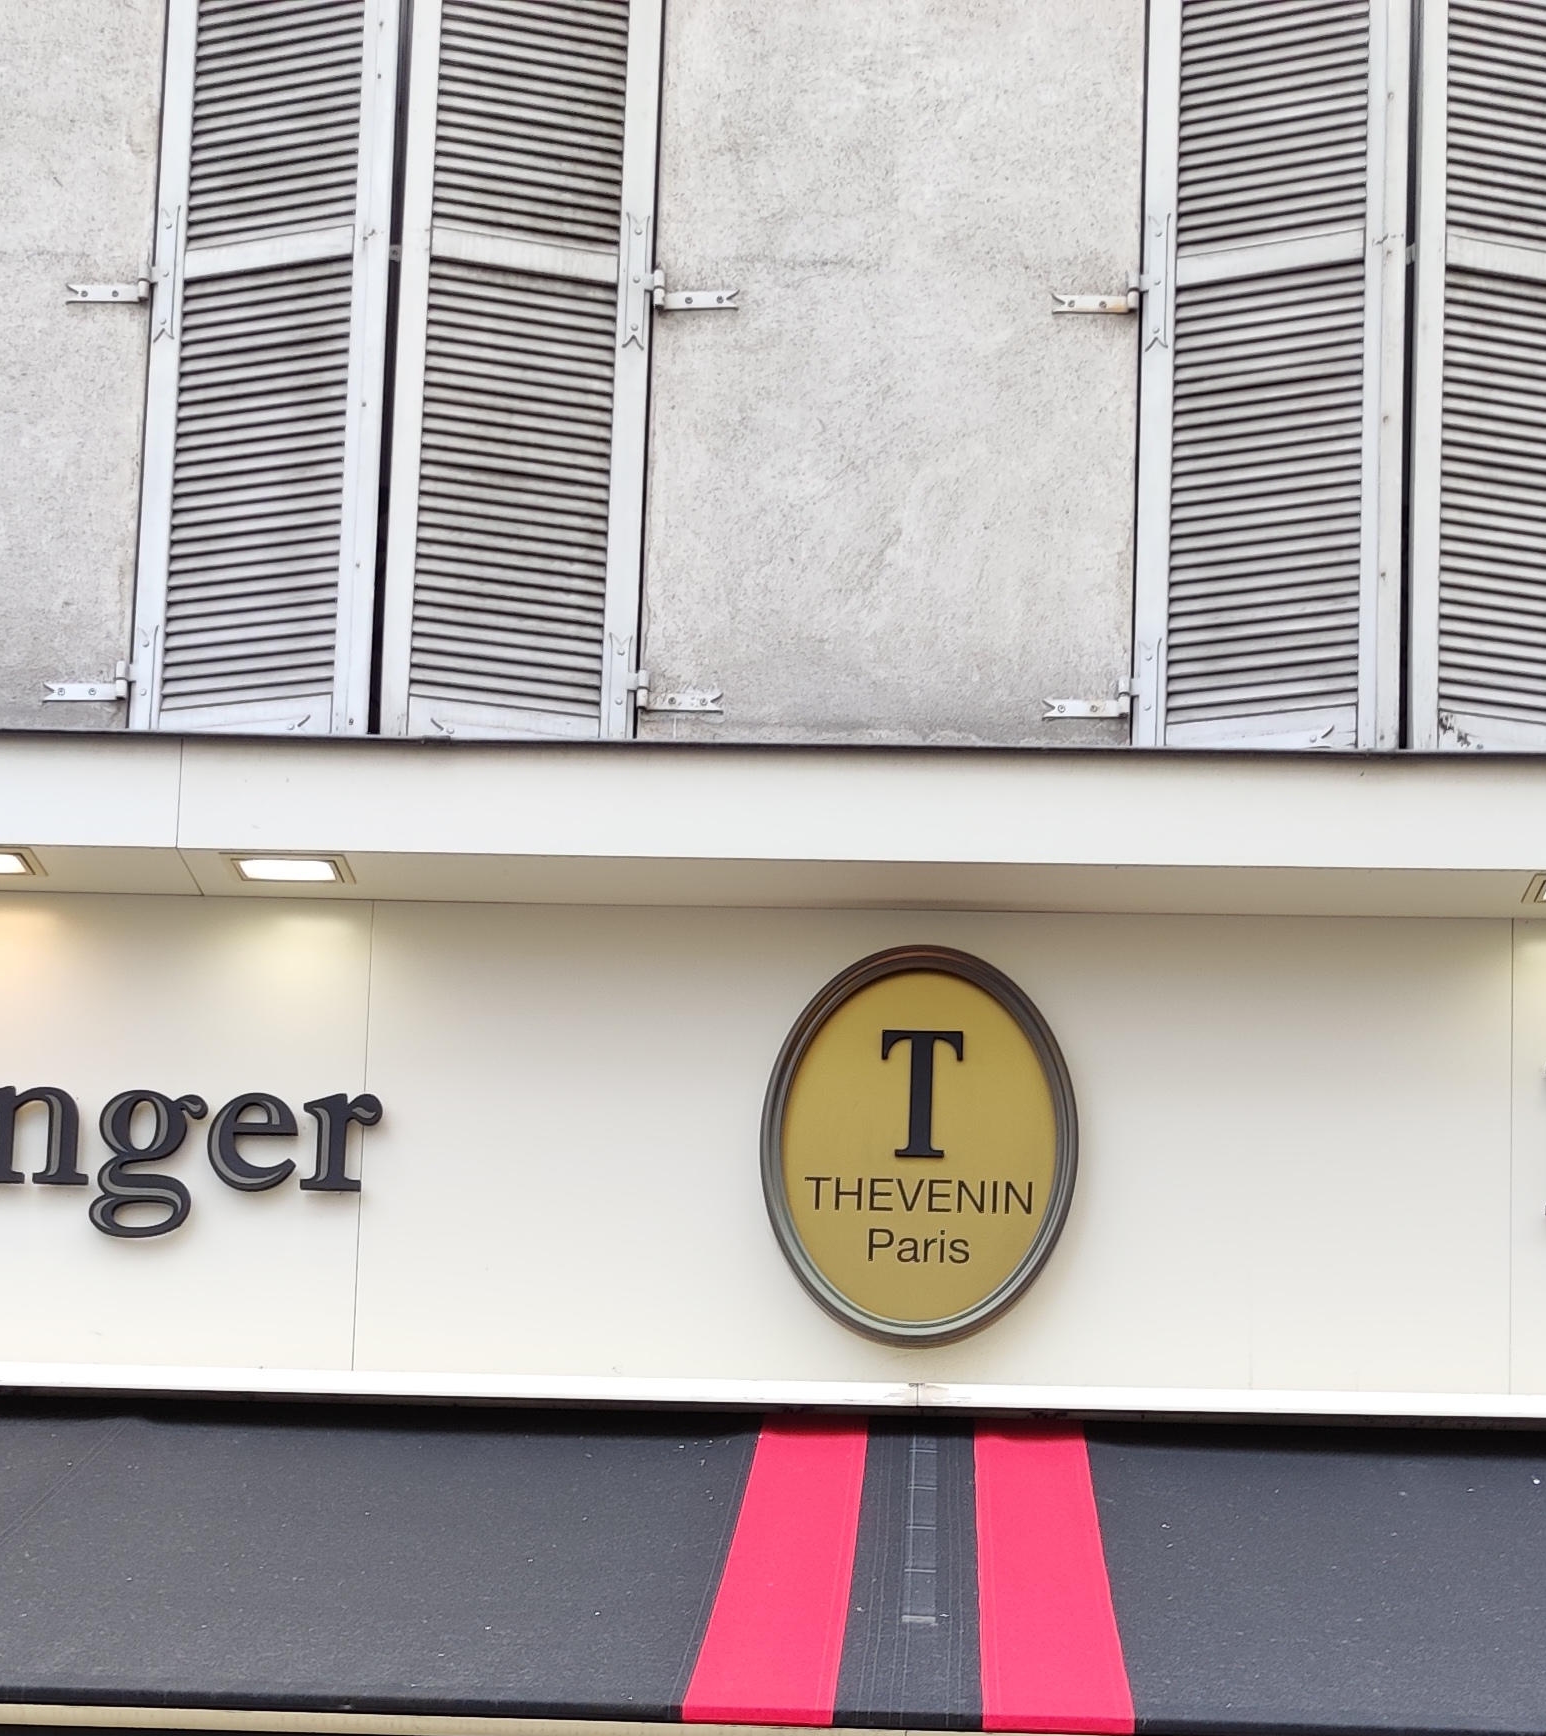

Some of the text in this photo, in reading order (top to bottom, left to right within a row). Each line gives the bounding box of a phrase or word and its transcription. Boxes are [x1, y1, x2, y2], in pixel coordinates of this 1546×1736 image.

[881, 1029, 964, 1159] T
[805, 1176, 1034, 1215] THEVENIN
[867, 1228, 971, 1265] Paris
